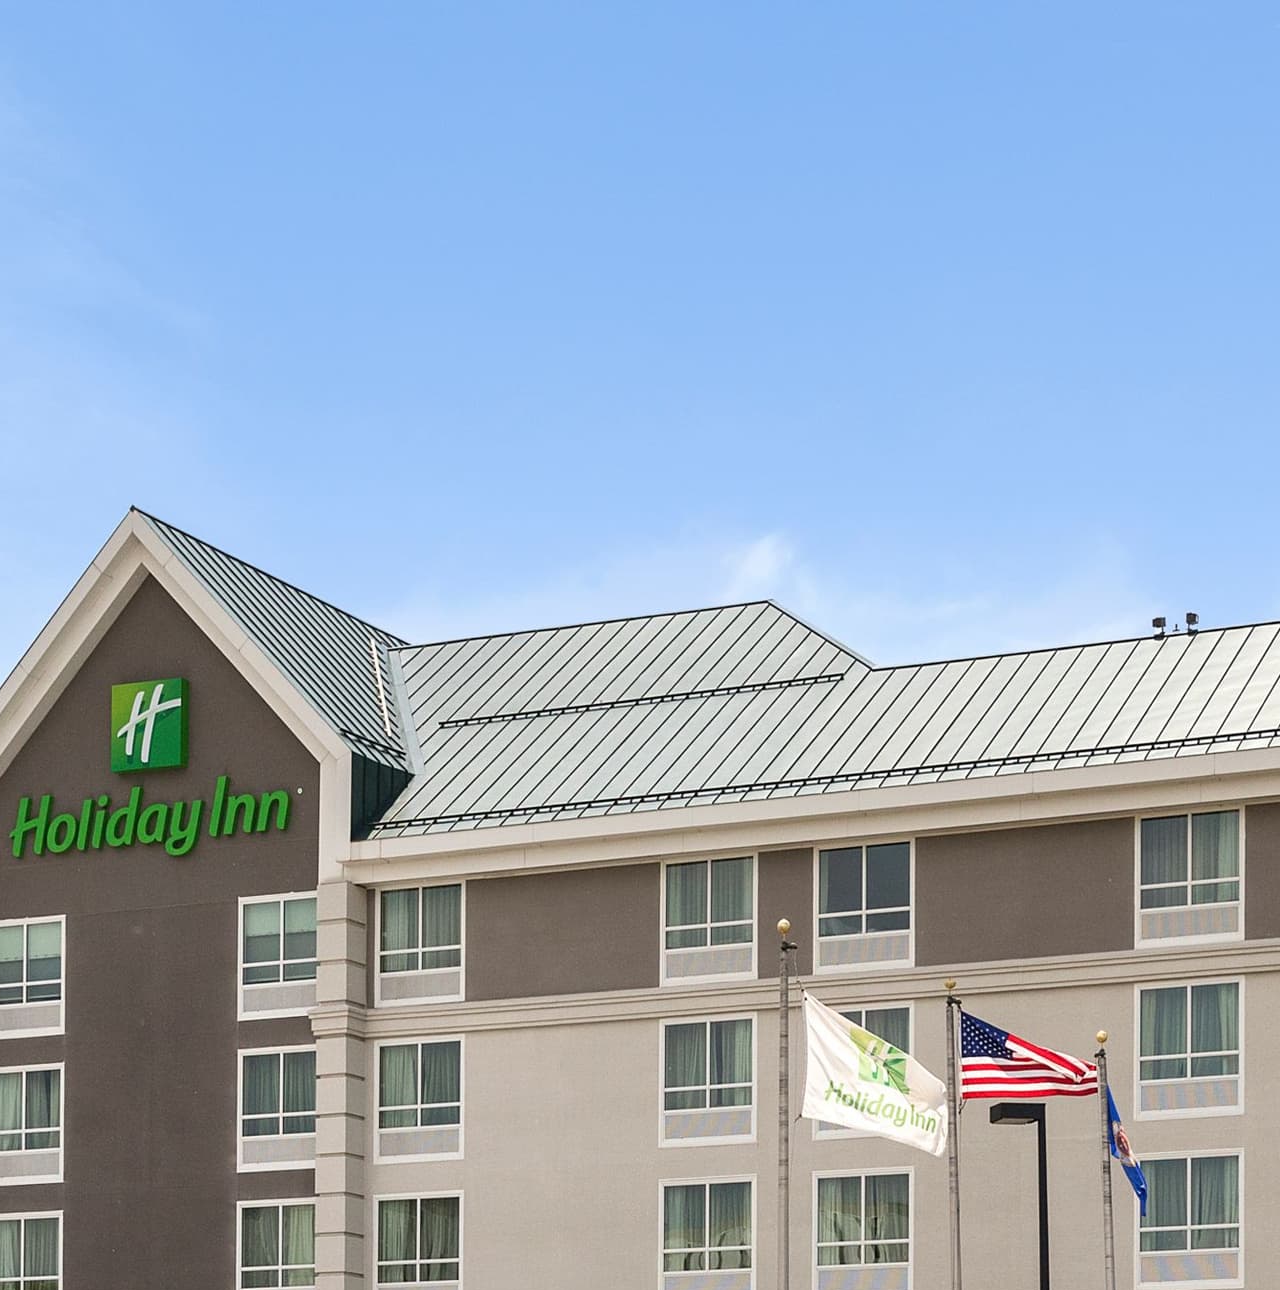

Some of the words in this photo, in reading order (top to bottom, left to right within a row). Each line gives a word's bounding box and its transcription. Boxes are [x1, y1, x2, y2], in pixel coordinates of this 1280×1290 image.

[117, 684, 182, 763] H
[9, 785, 203, 858] Holiday
[209, 775, 290, 838] Inn
[825, 1081, 908, 1128] Holiday
[909, 1104, 937, 1134] Inn
